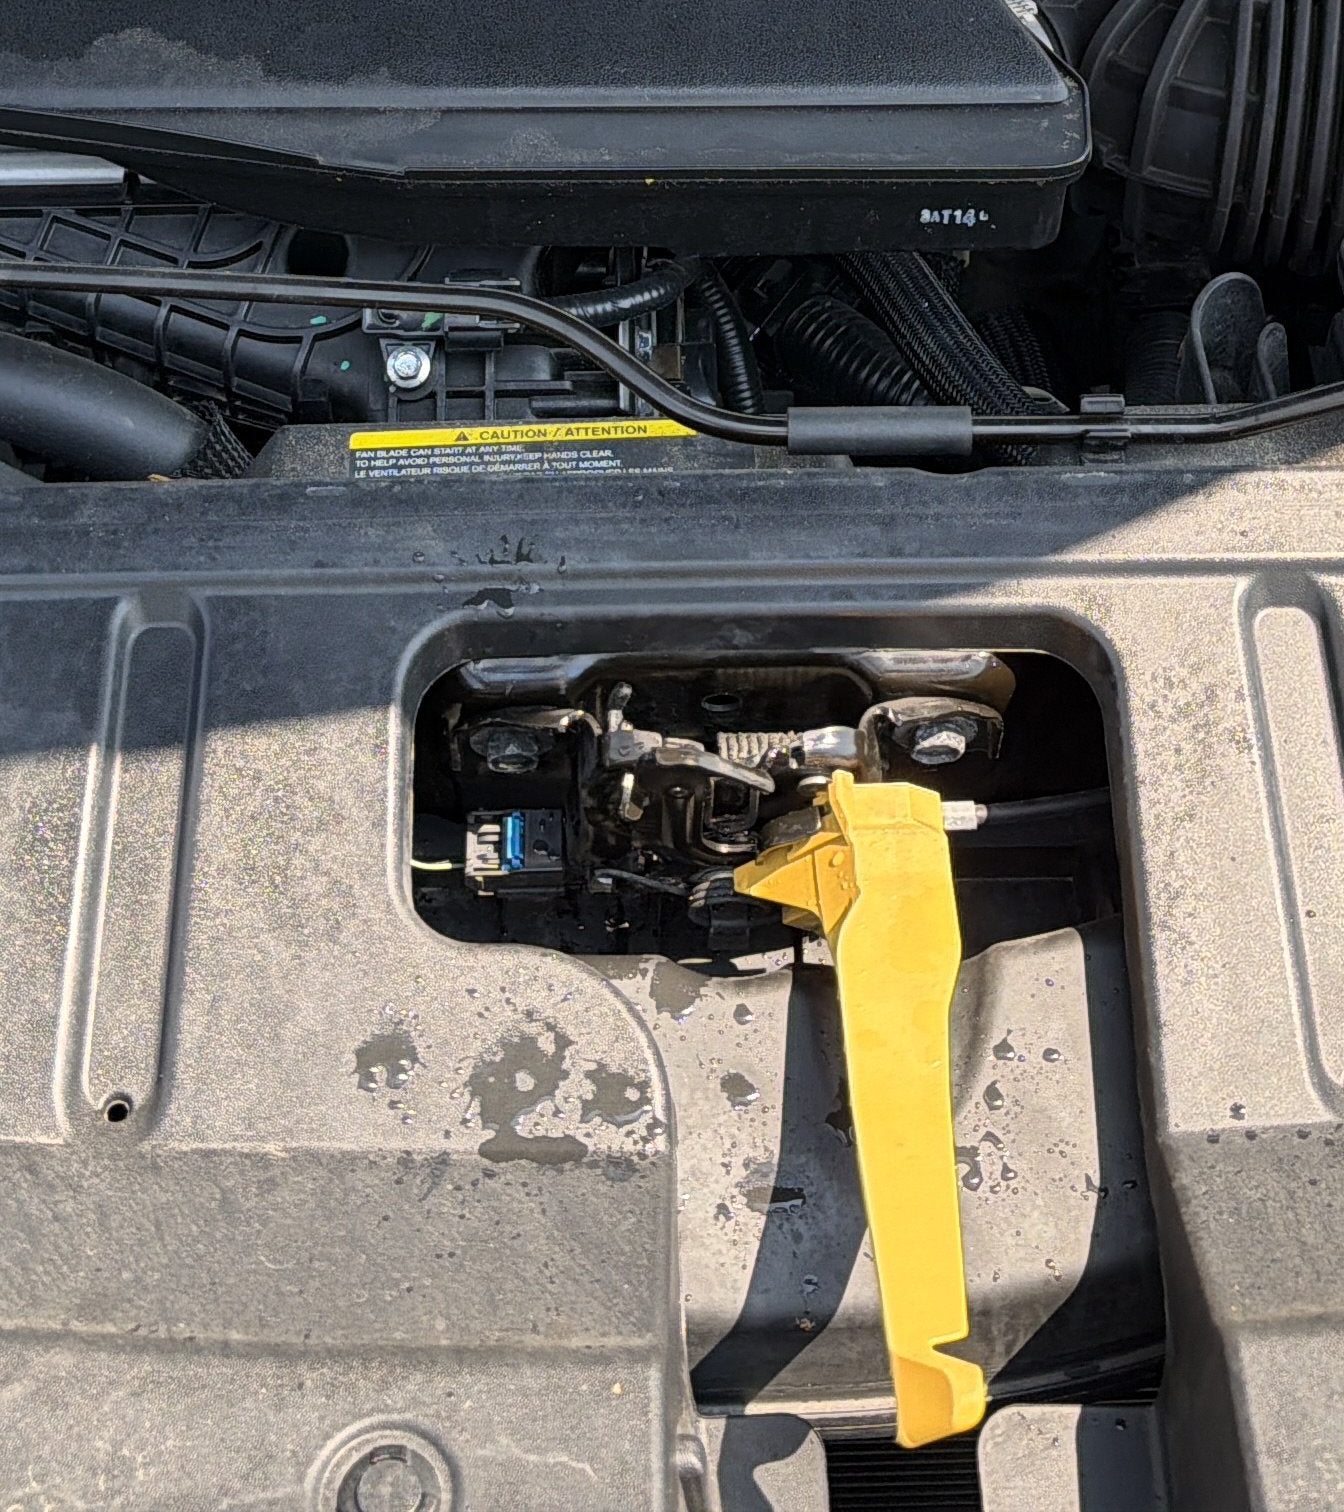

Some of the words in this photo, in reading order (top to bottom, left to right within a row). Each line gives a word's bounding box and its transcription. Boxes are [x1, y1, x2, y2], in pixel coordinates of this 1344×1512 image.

[479, 428, 547, 441] CAUTION
[565, 425, 648, 437] ATTENTION
[355, 450, 375, 458] FAN
[377, 449, 408, 458] BLADE
[410, 448, 432, 456] CAN
[433, 447, 463, 455] START
[479, 445, 499, 453] ANY
[355, 459, 369, 468] TO
[370, 458, 396, 467] HELP
[397, 457, 428, 466] AVOID
[429, 455, 481, 464] PERSONAL
[543, 451, 578, 459] HANDS
[354, 470, 367, 478] LE
[368, 466, 431, 477] VENTILATEUR
[433, 465, 470, 475] RISQUE
[552, 461, 577, 469] TOUT
